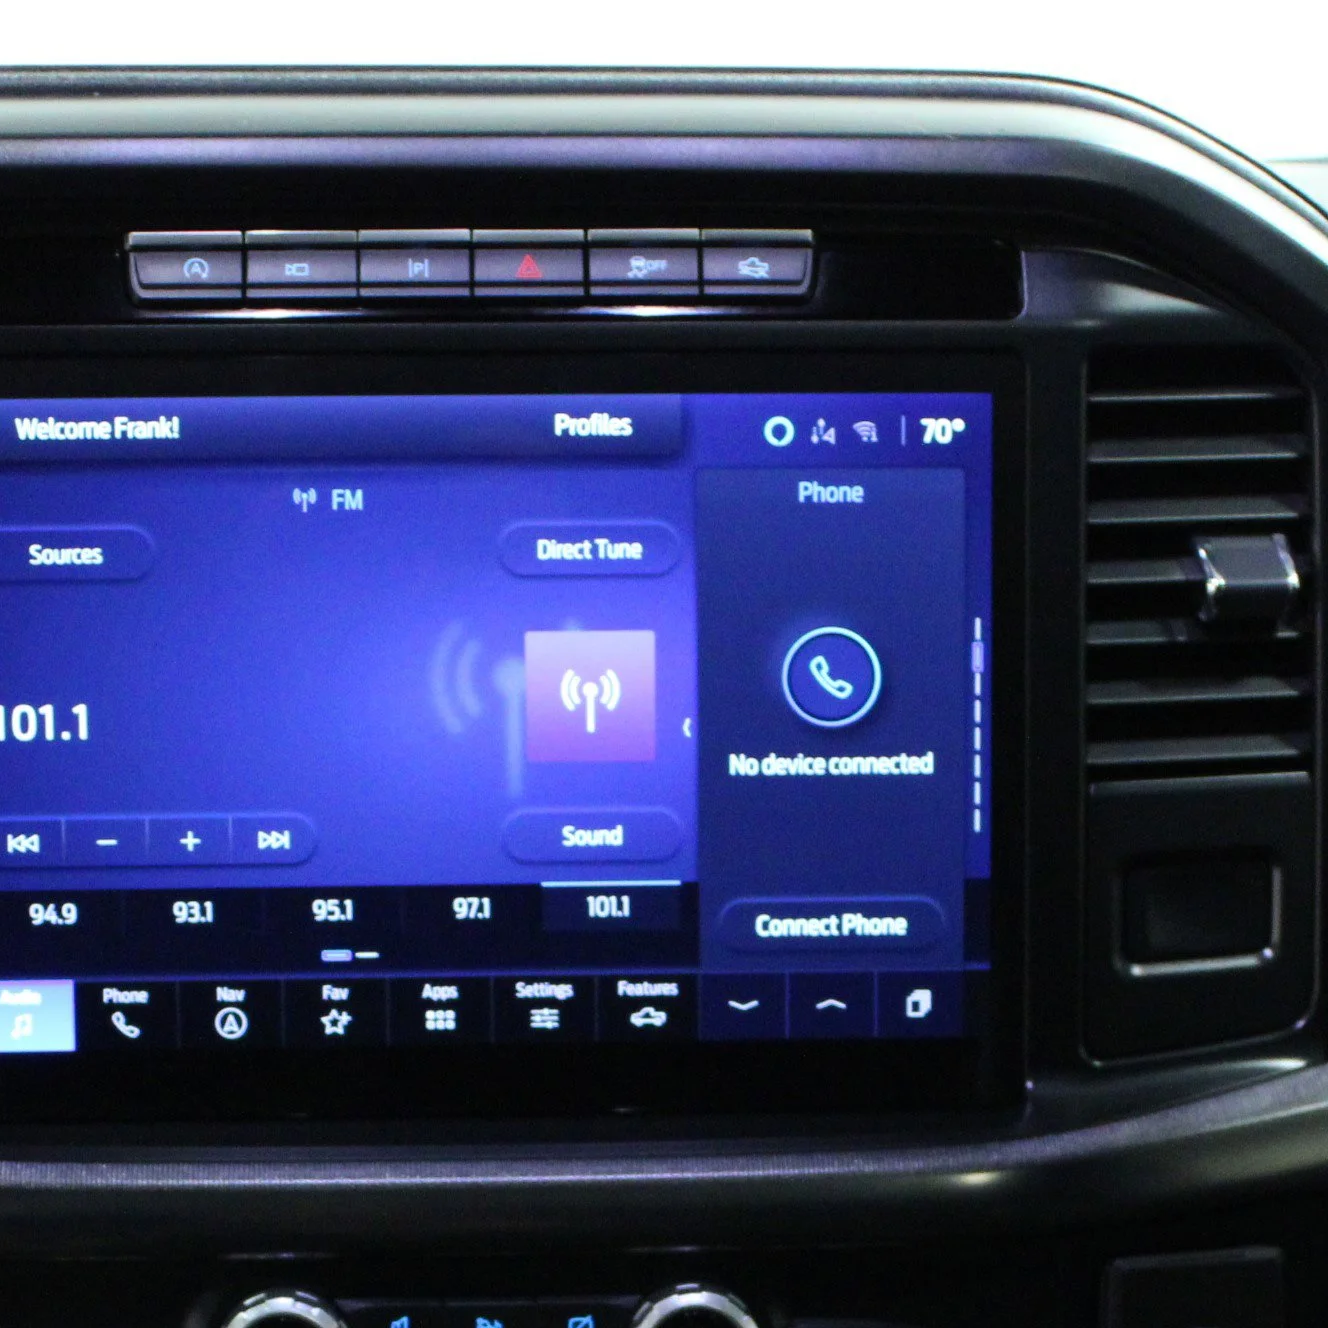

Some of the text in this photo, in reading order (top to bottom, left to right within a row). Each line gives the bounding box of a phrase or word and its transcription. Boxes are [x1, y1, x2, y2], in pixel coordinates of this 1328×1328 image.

[15, 417, 180, 440] Welcome Frank!
[554, 413, 633, 437] Profiles
[331, 489, 364, 511] FM
[798, 481, 864, 503] Phone
[28, 544, 103, 566] Sources
[537, 538, 643, 561] Direct Tune
[729, 752, 934, 776] No device connected
[562, 826, 623, 848] Sound
[29, 902, 78, 926] 94.9
[172, 900, 214, 924] 93.1
[312, 899, 354, 922] 95.1
[452, 896, 491, 920] 97.1
[586, 896, 630, 918] 101.1
[755, 914, 908, 937] Connect Phone
[103, 988, 149, 1004] Phone
[217, 986, 246, 1003] Nav
[322, 984, 350, 1001] Fav
[422, 983, 459, 1002] Apps
[515, 981, 574, 1000] Settings
[617, 980, 679, 997] Features
